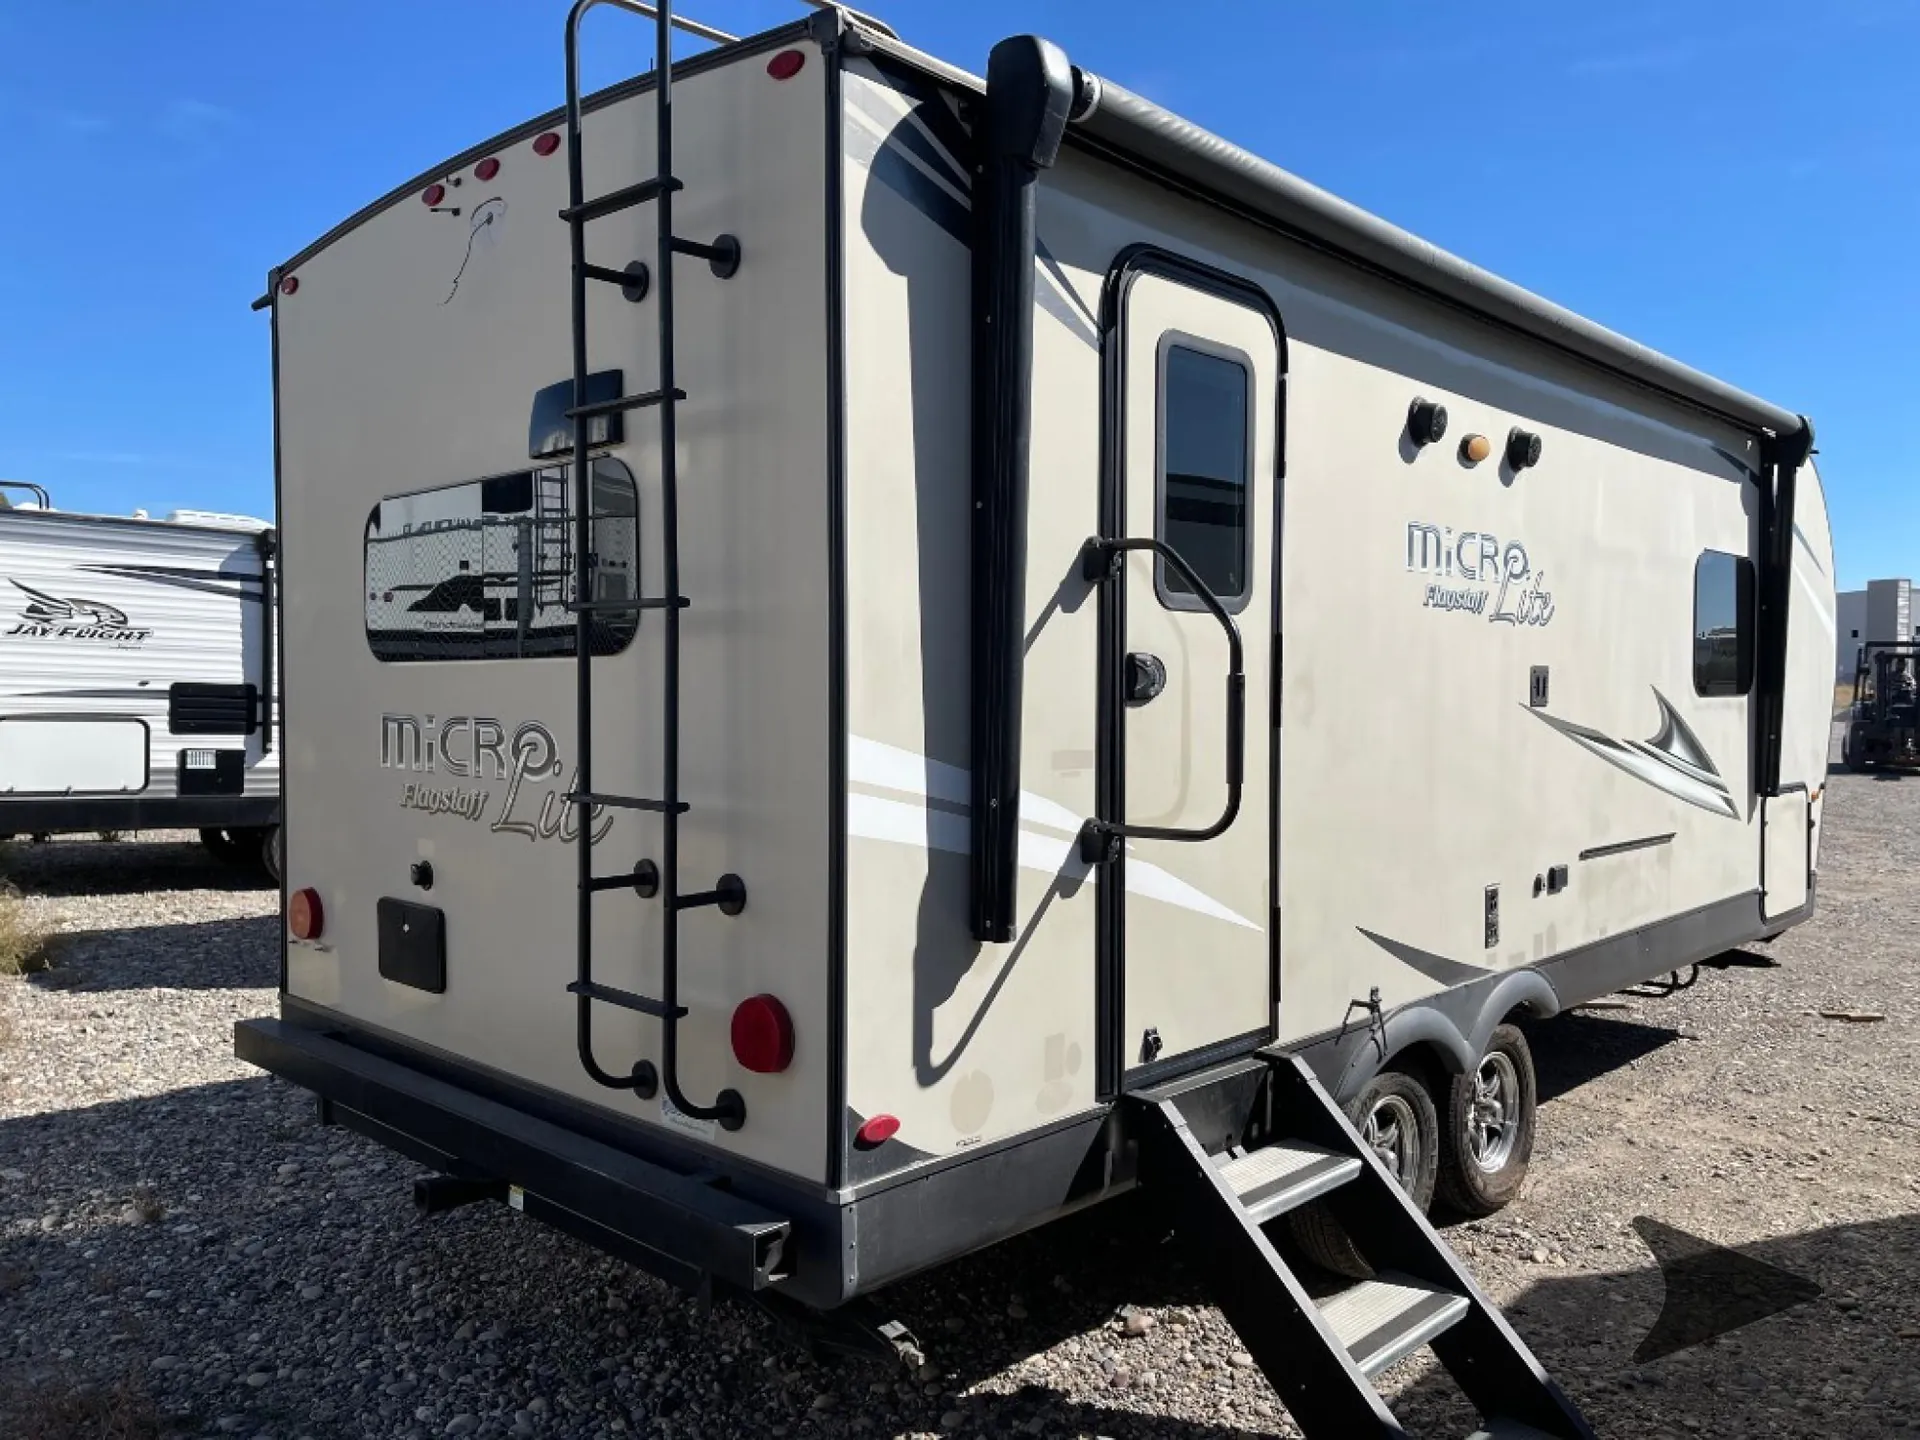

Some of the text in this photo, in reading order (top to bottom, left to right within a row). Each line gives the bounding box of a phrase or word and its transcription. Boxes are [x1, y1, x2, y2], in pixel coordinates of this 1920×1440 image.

[1422, 582, 1490, 615] Flagstaff
[1488, 556, 1555, 627] Lite
[5, 622, 153, 642] JAY FLIGHT
[400, 782, 491, 822] Flagstaff
